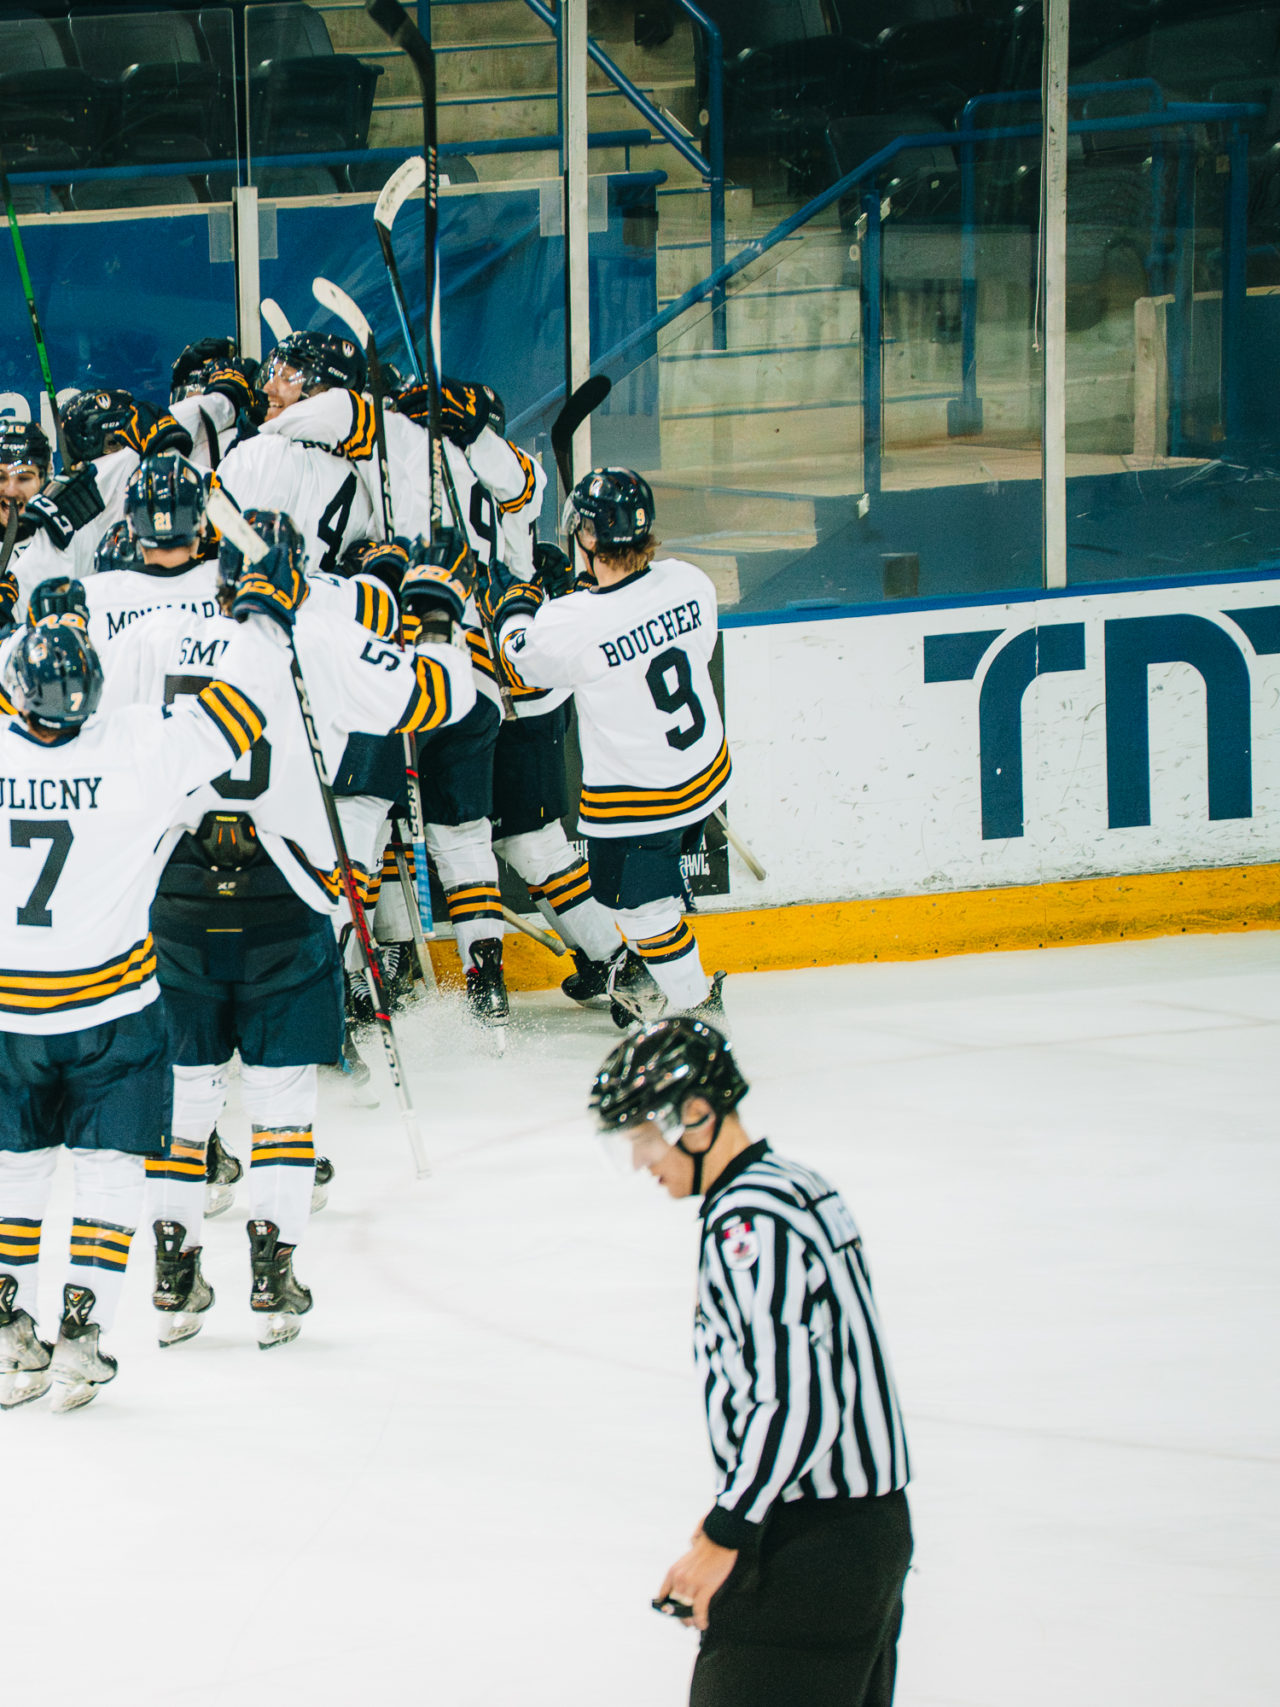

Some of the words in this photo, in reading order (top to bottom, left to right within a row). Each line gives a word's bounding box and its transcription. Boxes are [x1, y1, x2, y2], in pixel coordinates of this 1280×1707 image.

[317, 471, 357, 573] 4
[635, 507, 646, 527] 9
[599, 600, 703, 667] BOUCHER
[70, 691, 84, 712] 7
[645, 646, 707, 751] 9
[10, 819, 74, 927] 7
